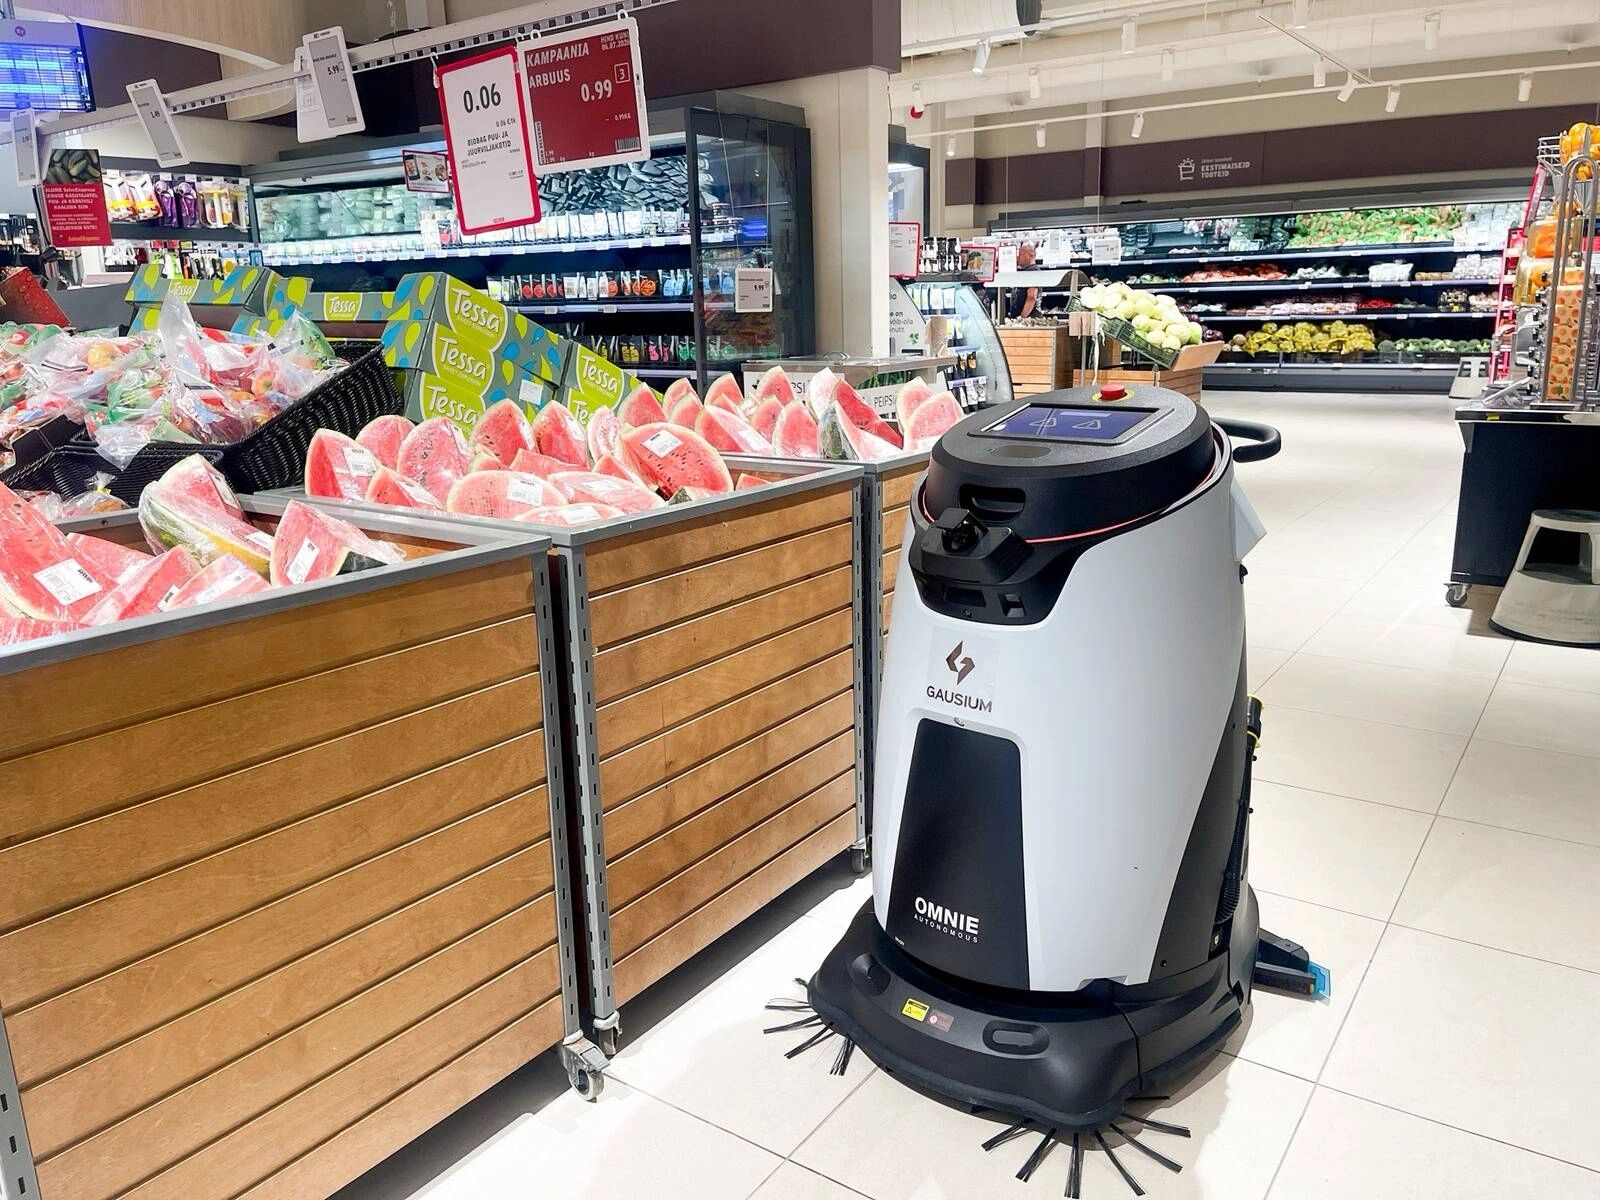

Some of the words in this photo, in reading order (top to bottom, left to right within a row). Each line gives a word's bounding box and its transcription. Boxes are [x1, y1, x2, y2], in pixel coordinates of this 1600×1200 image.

[526, 42, 589, 68] KAMPAANIA
[528, 69, 571, 89] ARBUUS
[619, 68, 625, 80] 3
[463, 83, 502, 113] 0.06
[580, 79, 613, 102] 0.99
[501, 130, 509, 139] JA
[328, 296, 357, 314] Tessa
[450, 287, 500, 334] Tessa
[437, 336, 488, 381] Tessa
[580, 355, 618, 393] Tessa
[425, 385, 480, 426] Tessa
[926, 685, 993, 713] GAUSIUM
[914, 914, 979, 944] AUTONOMOUS
[915, 896, 980, 936] OMNIE
